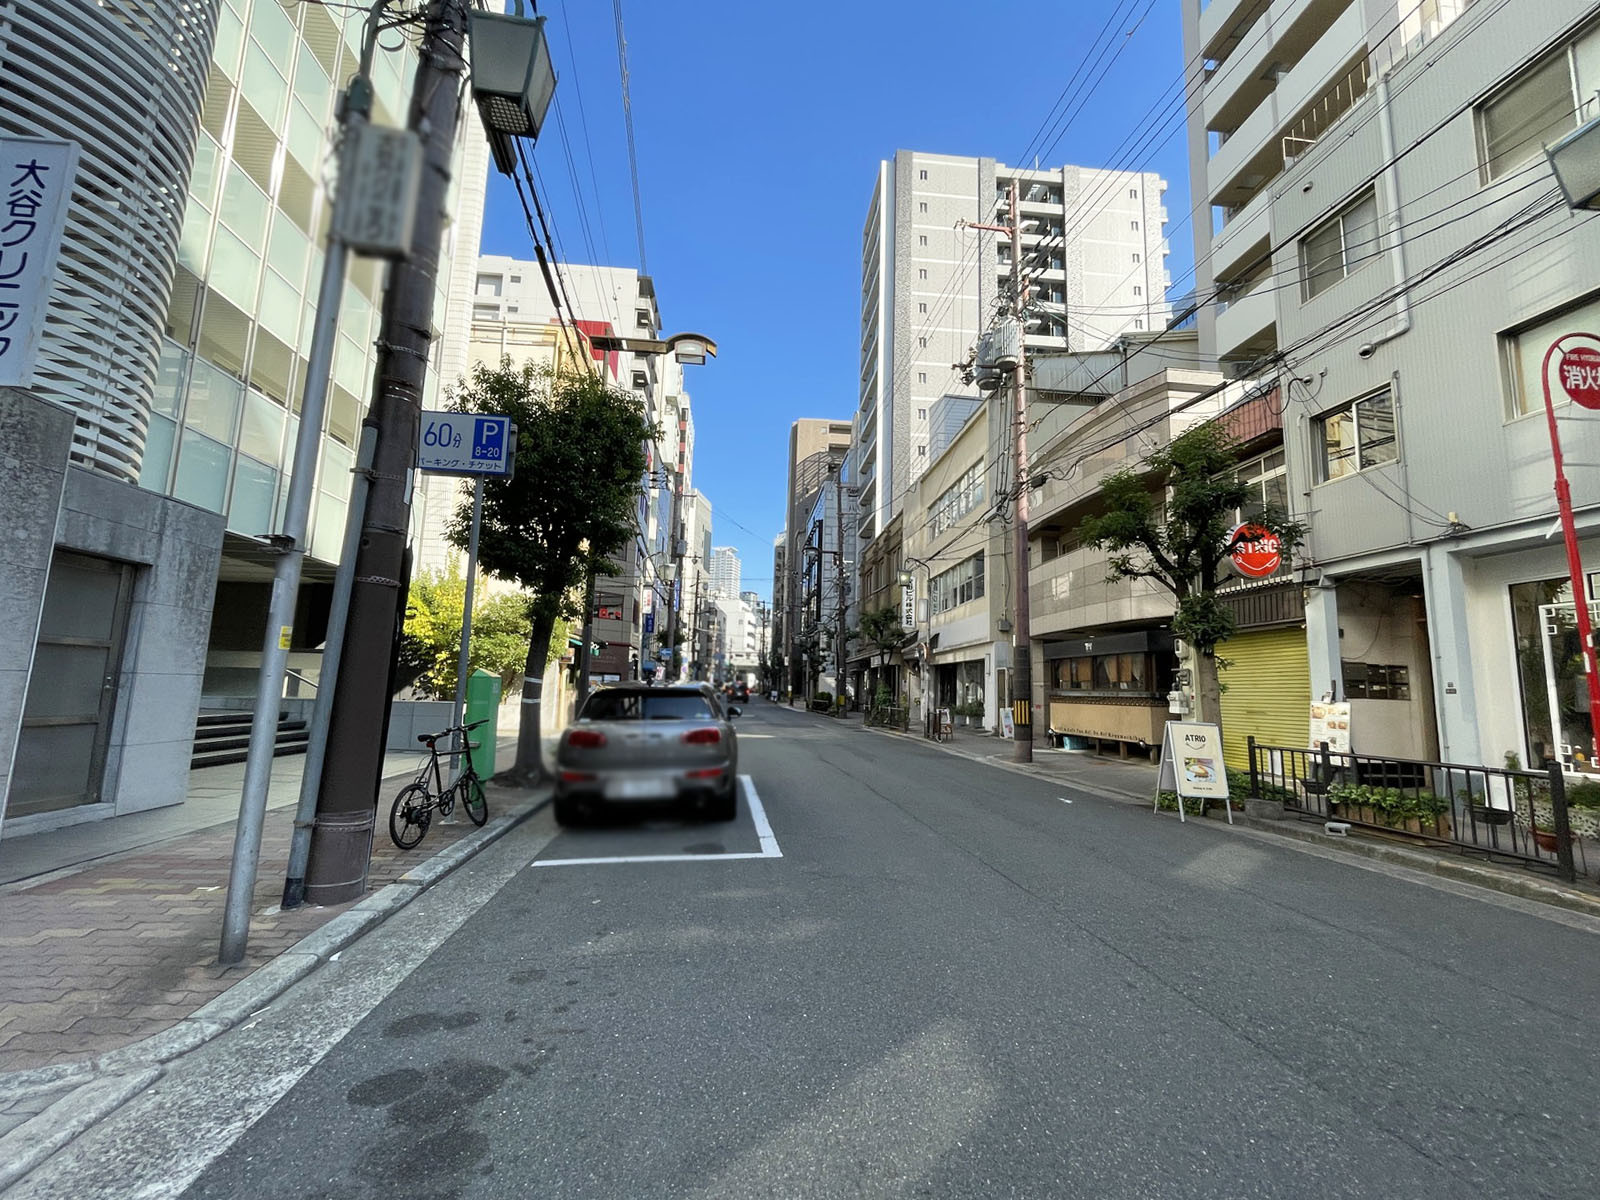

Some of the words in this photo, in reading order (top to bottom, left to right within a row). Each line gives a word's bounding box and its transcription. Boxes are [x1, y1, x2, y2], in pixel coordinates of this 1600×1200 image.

[424, 422, 462, 448] 60分
[482, 422, 499, 444] P
[475, 446, 500, 457] 8-20
[1185, 734, 1206, 743] ATRIO
